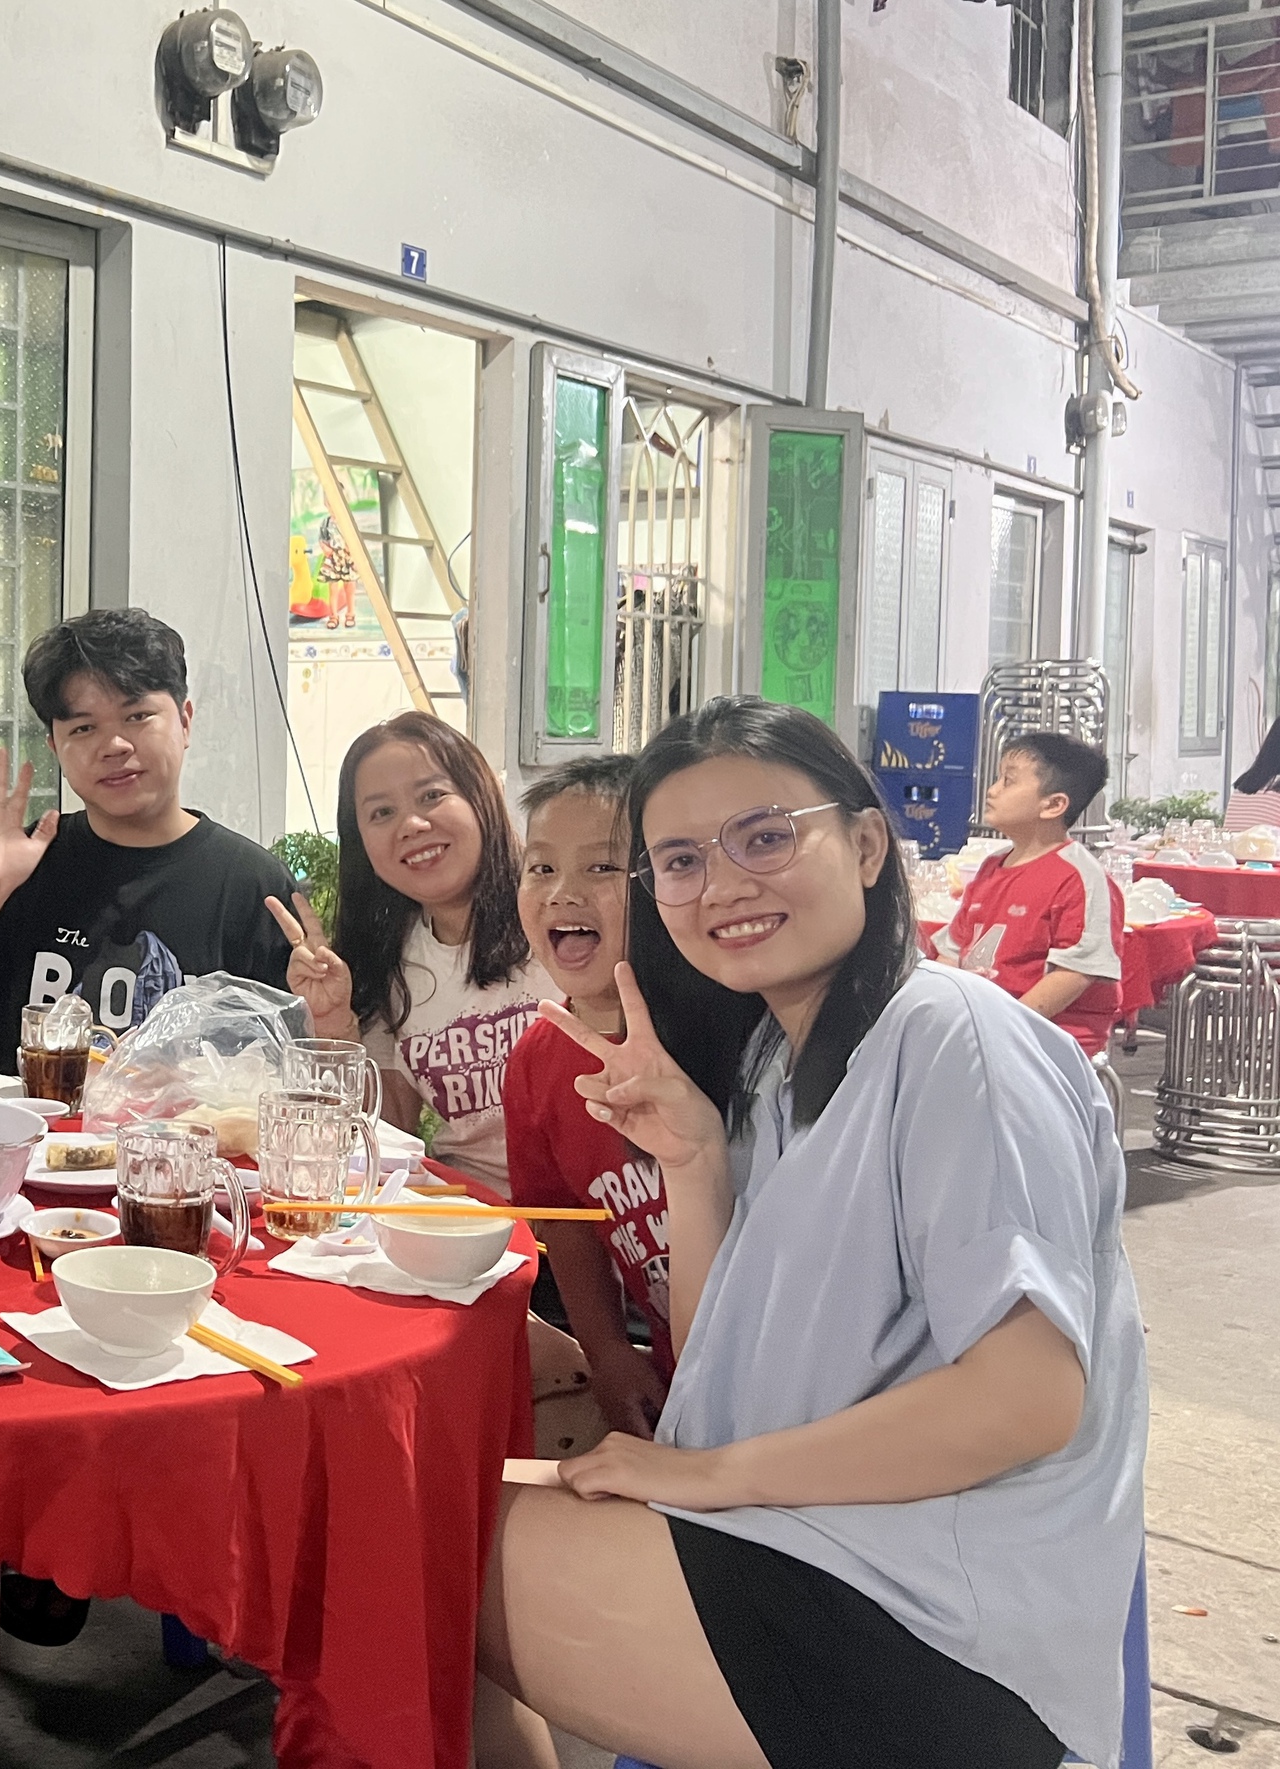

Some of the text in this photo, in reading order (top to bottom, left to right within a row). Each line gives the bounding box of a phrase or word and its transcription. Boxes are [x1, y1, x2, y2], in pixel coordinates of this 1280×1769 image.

[410, 250, 419, 275] 7
[55, 927, 90, 948] The
[442, 1066, 505, 1113] RIN
[610, 1221, 648, 1270] THE
